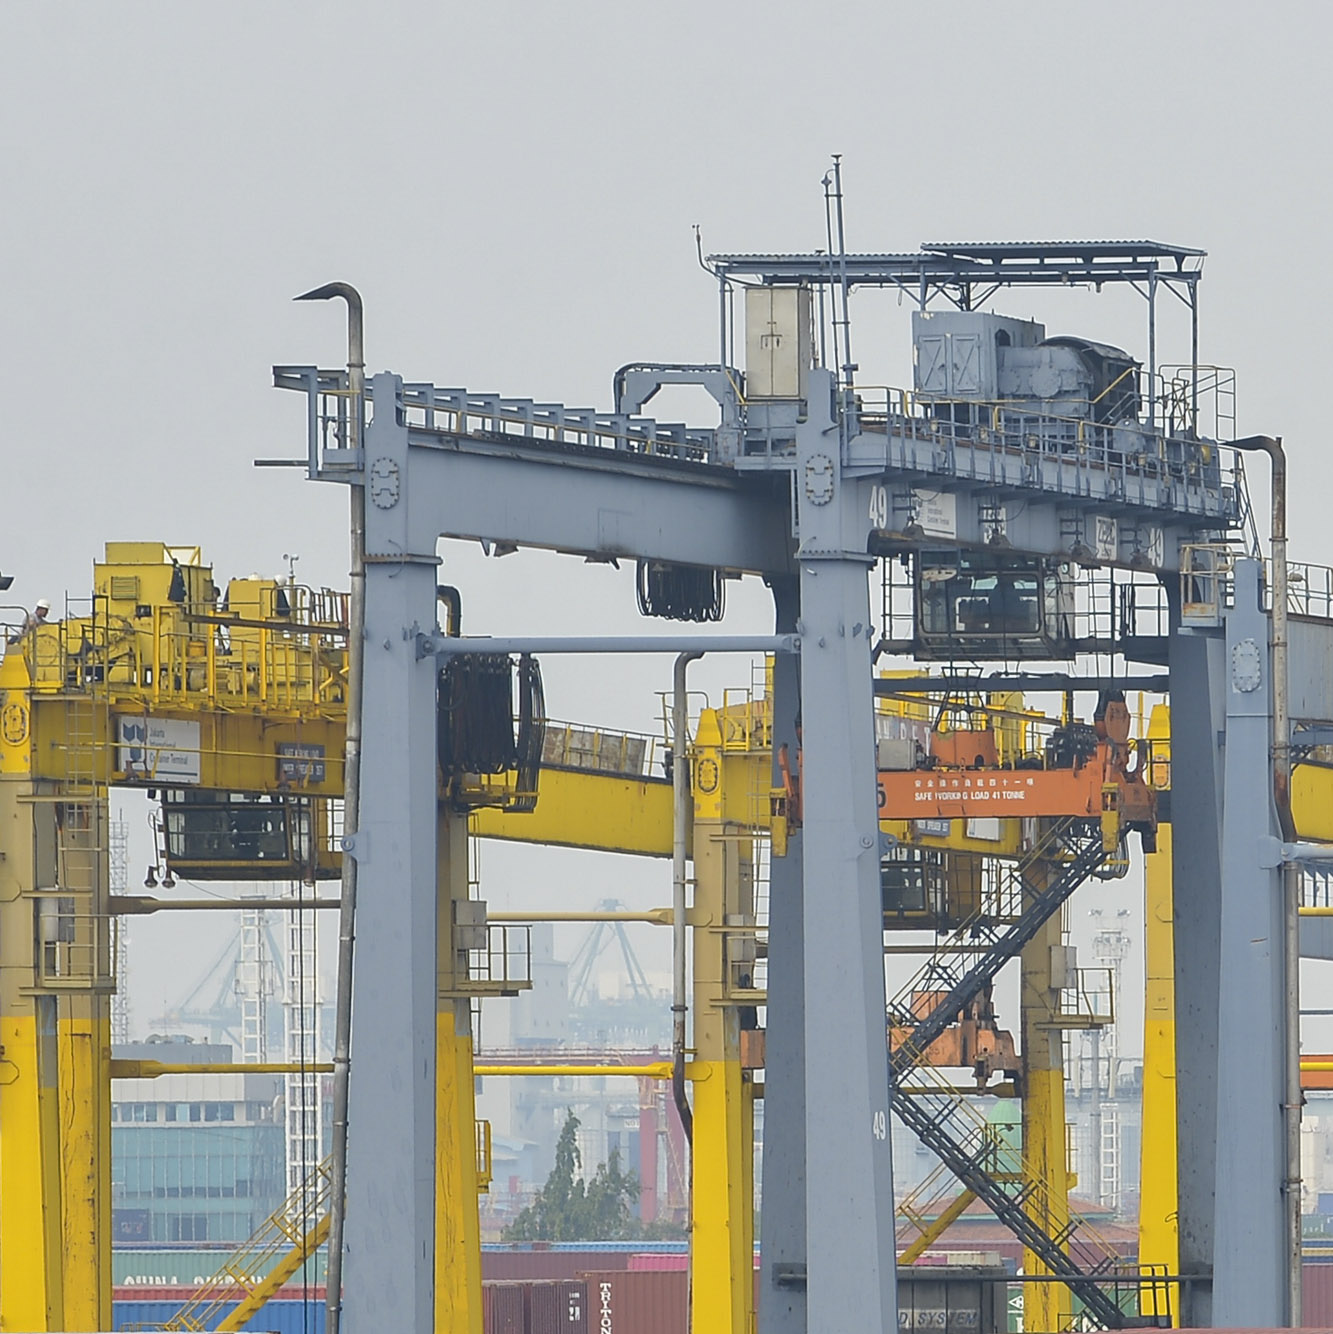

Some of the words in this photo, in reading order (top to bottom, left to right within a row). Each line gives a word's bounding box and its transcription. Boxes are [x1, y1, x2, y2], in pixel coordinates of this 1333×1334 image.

[869, 486, 886, 529] 49
[915, 792, 931, 800] SAFE
[998, 791, 1024, 799] TONNE
[874, 1112, 885, 1139] 49
[917, 1309, 977, 1326] SYSTEM
